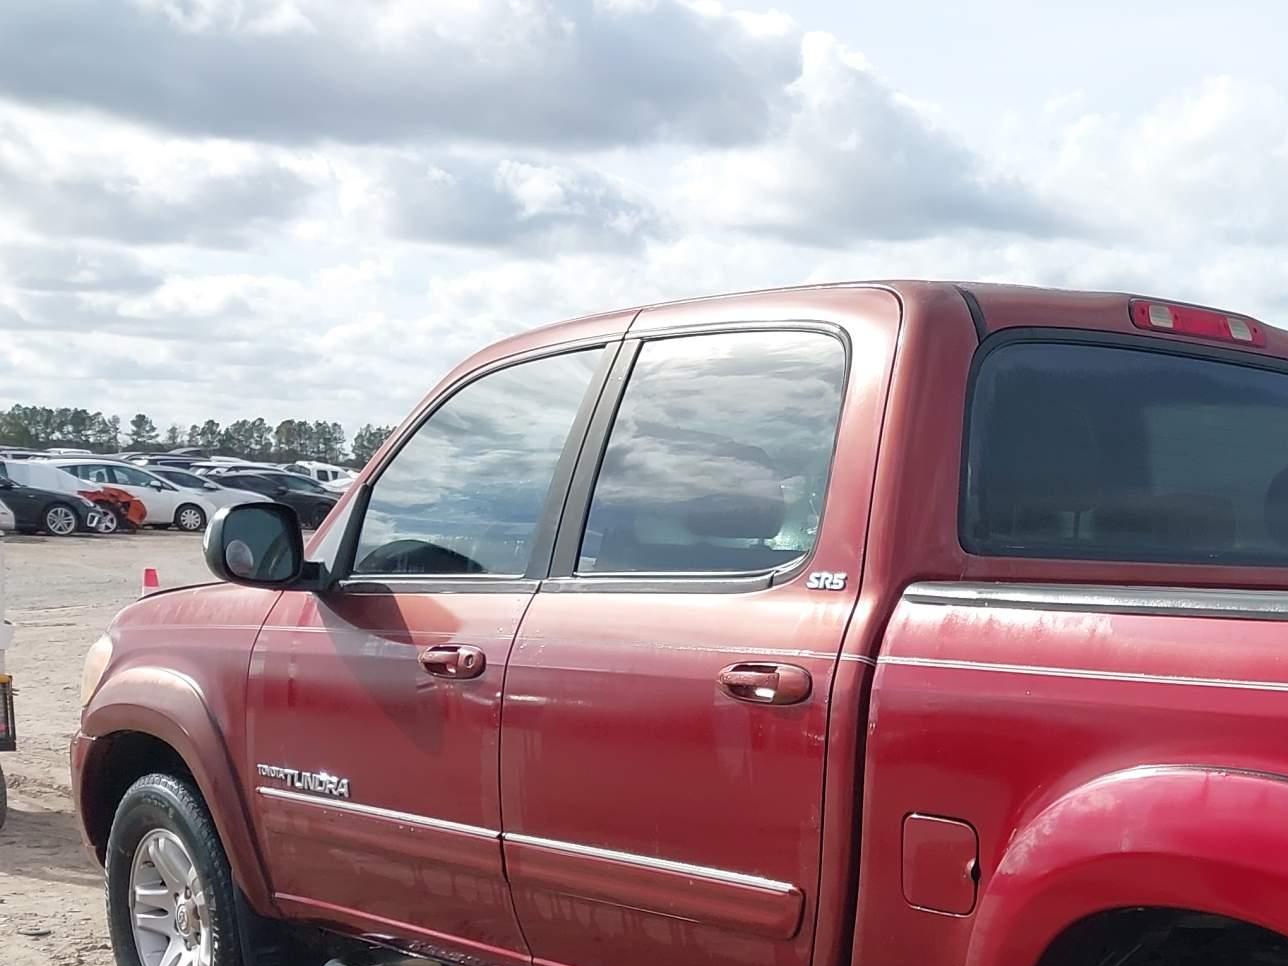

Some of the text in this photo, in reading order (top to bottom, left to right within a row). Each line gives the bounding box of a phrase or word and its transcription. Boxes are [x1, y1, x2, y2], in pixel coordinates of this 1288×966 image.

[806, 572, 848, 590] SR5
[257, 763, 350, 798] TOYOTA TUNDRA
